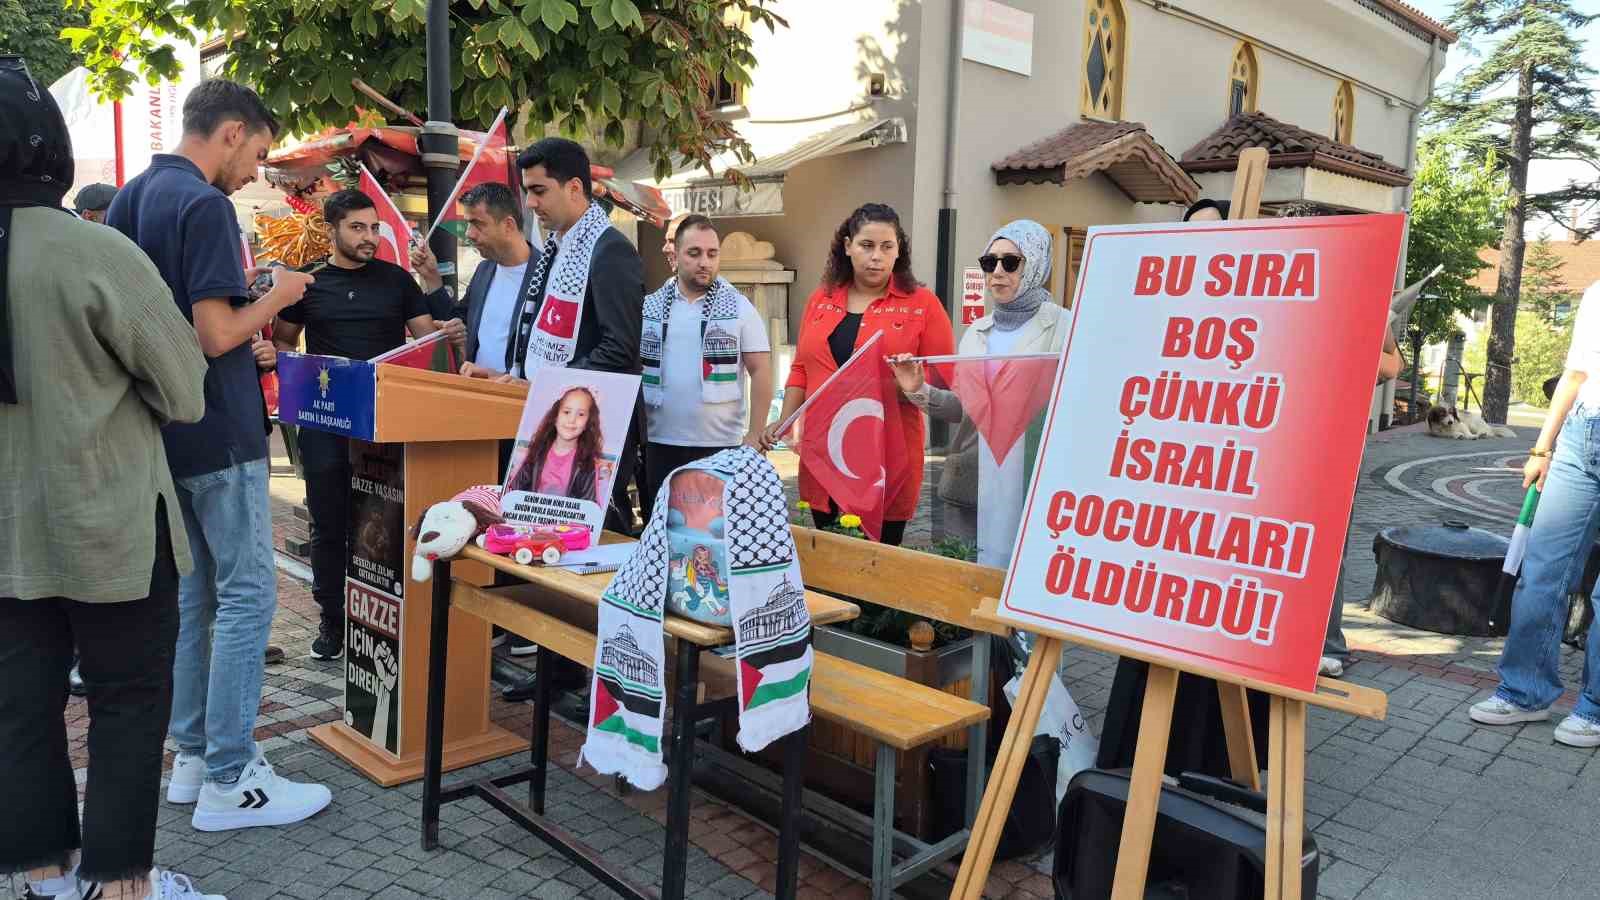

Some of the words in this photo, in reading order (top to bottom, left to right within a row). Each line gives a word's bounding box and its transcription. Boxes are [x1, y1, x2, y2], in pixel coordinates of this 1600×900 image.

[149, 83, 163, 151] BAKANL
[1135, 254, 1196, 296] BU
[1205, 254, 1316, 296] SIRA
[1162, 316, 1258, 369] BOŞ
[312, 399, 321, 409] AK
[1118, 371, 1281, 429] ÇÜNKÜ
[1109, 429, 1257, 495] İSRAİL
[351, 476, 373, 494] GAZZE
[374, 481, 404, 505] YAŞASIN
[1046, 490, 1310, 575] ÇOCUKLARI
[350, 588, 397, 635] GAZZE
[1045, 546, 1281, 639] ÖLDÜRDÜ!
[349, 622, 374, 658] İÇİN
[348, 661, 379, 697] DİREN
